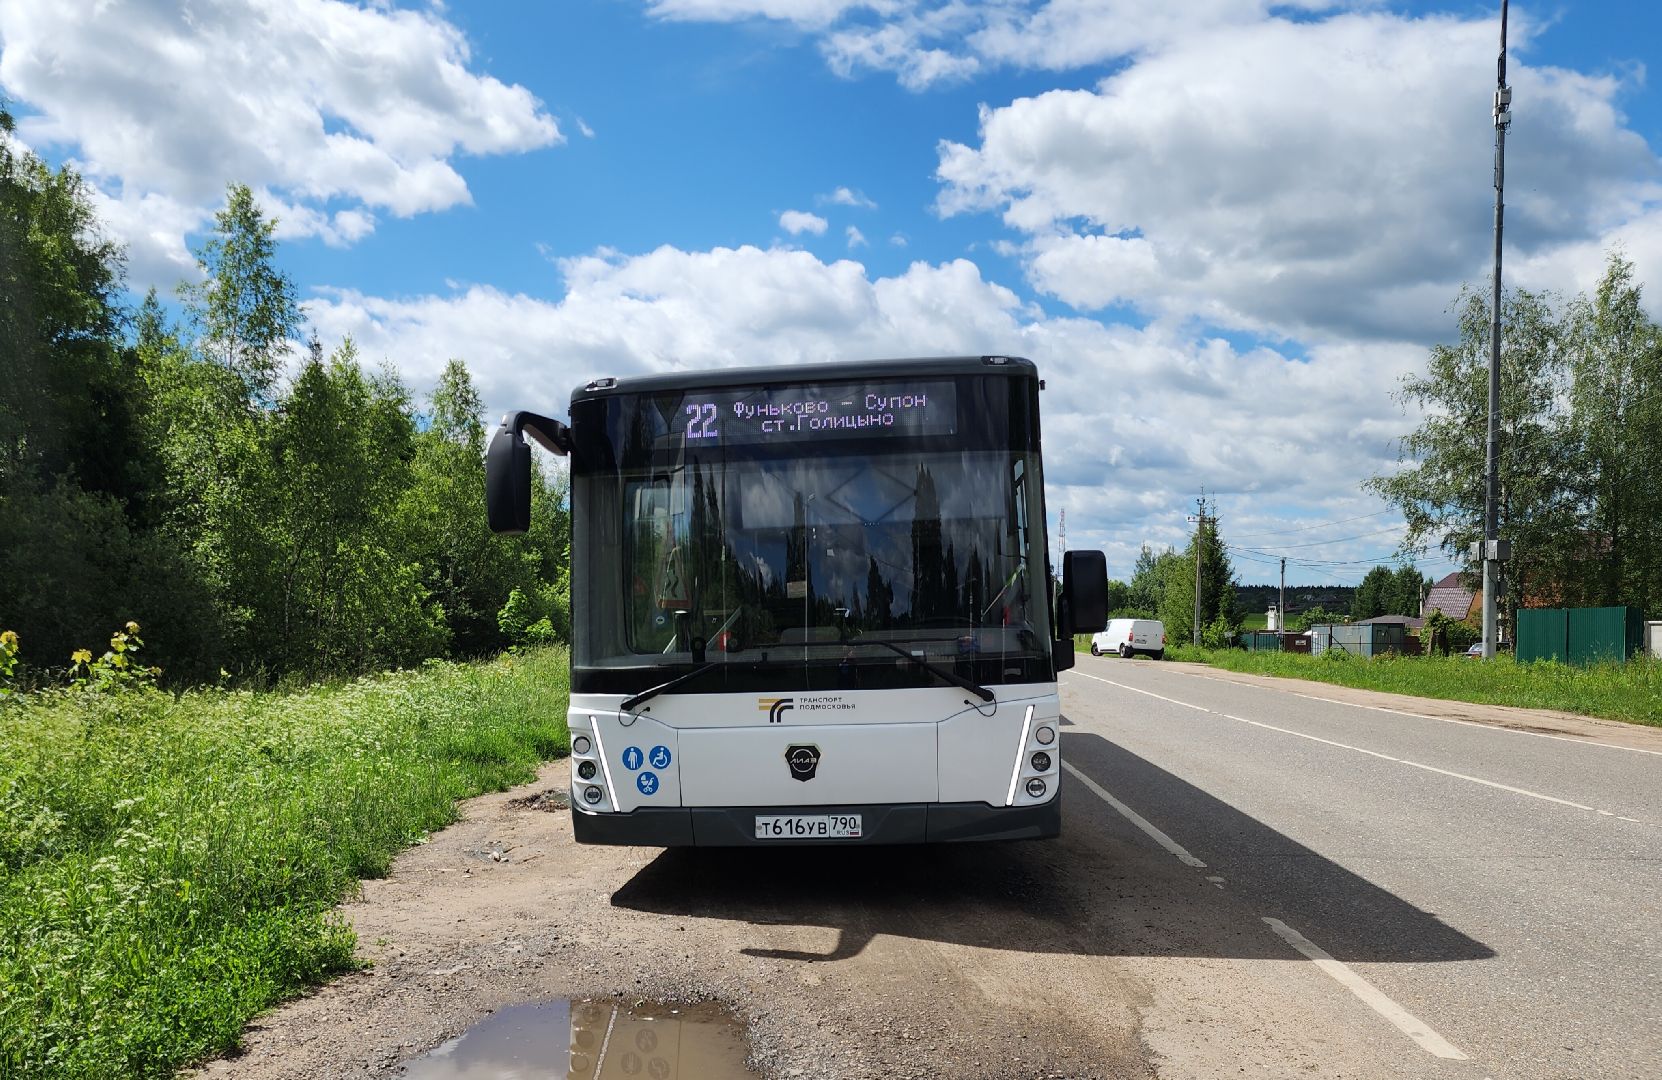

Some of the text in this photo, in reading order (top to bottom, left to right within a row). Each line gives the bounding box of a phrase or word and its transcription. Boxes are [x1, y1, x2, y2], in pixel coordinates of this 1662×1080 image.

[733, 401, 829, 419] Фуньково
[865, 394, 927, 411] Супон
[686, 403, 718, 438] 22
[761, 816, 857, 835] Т616УВ 790
